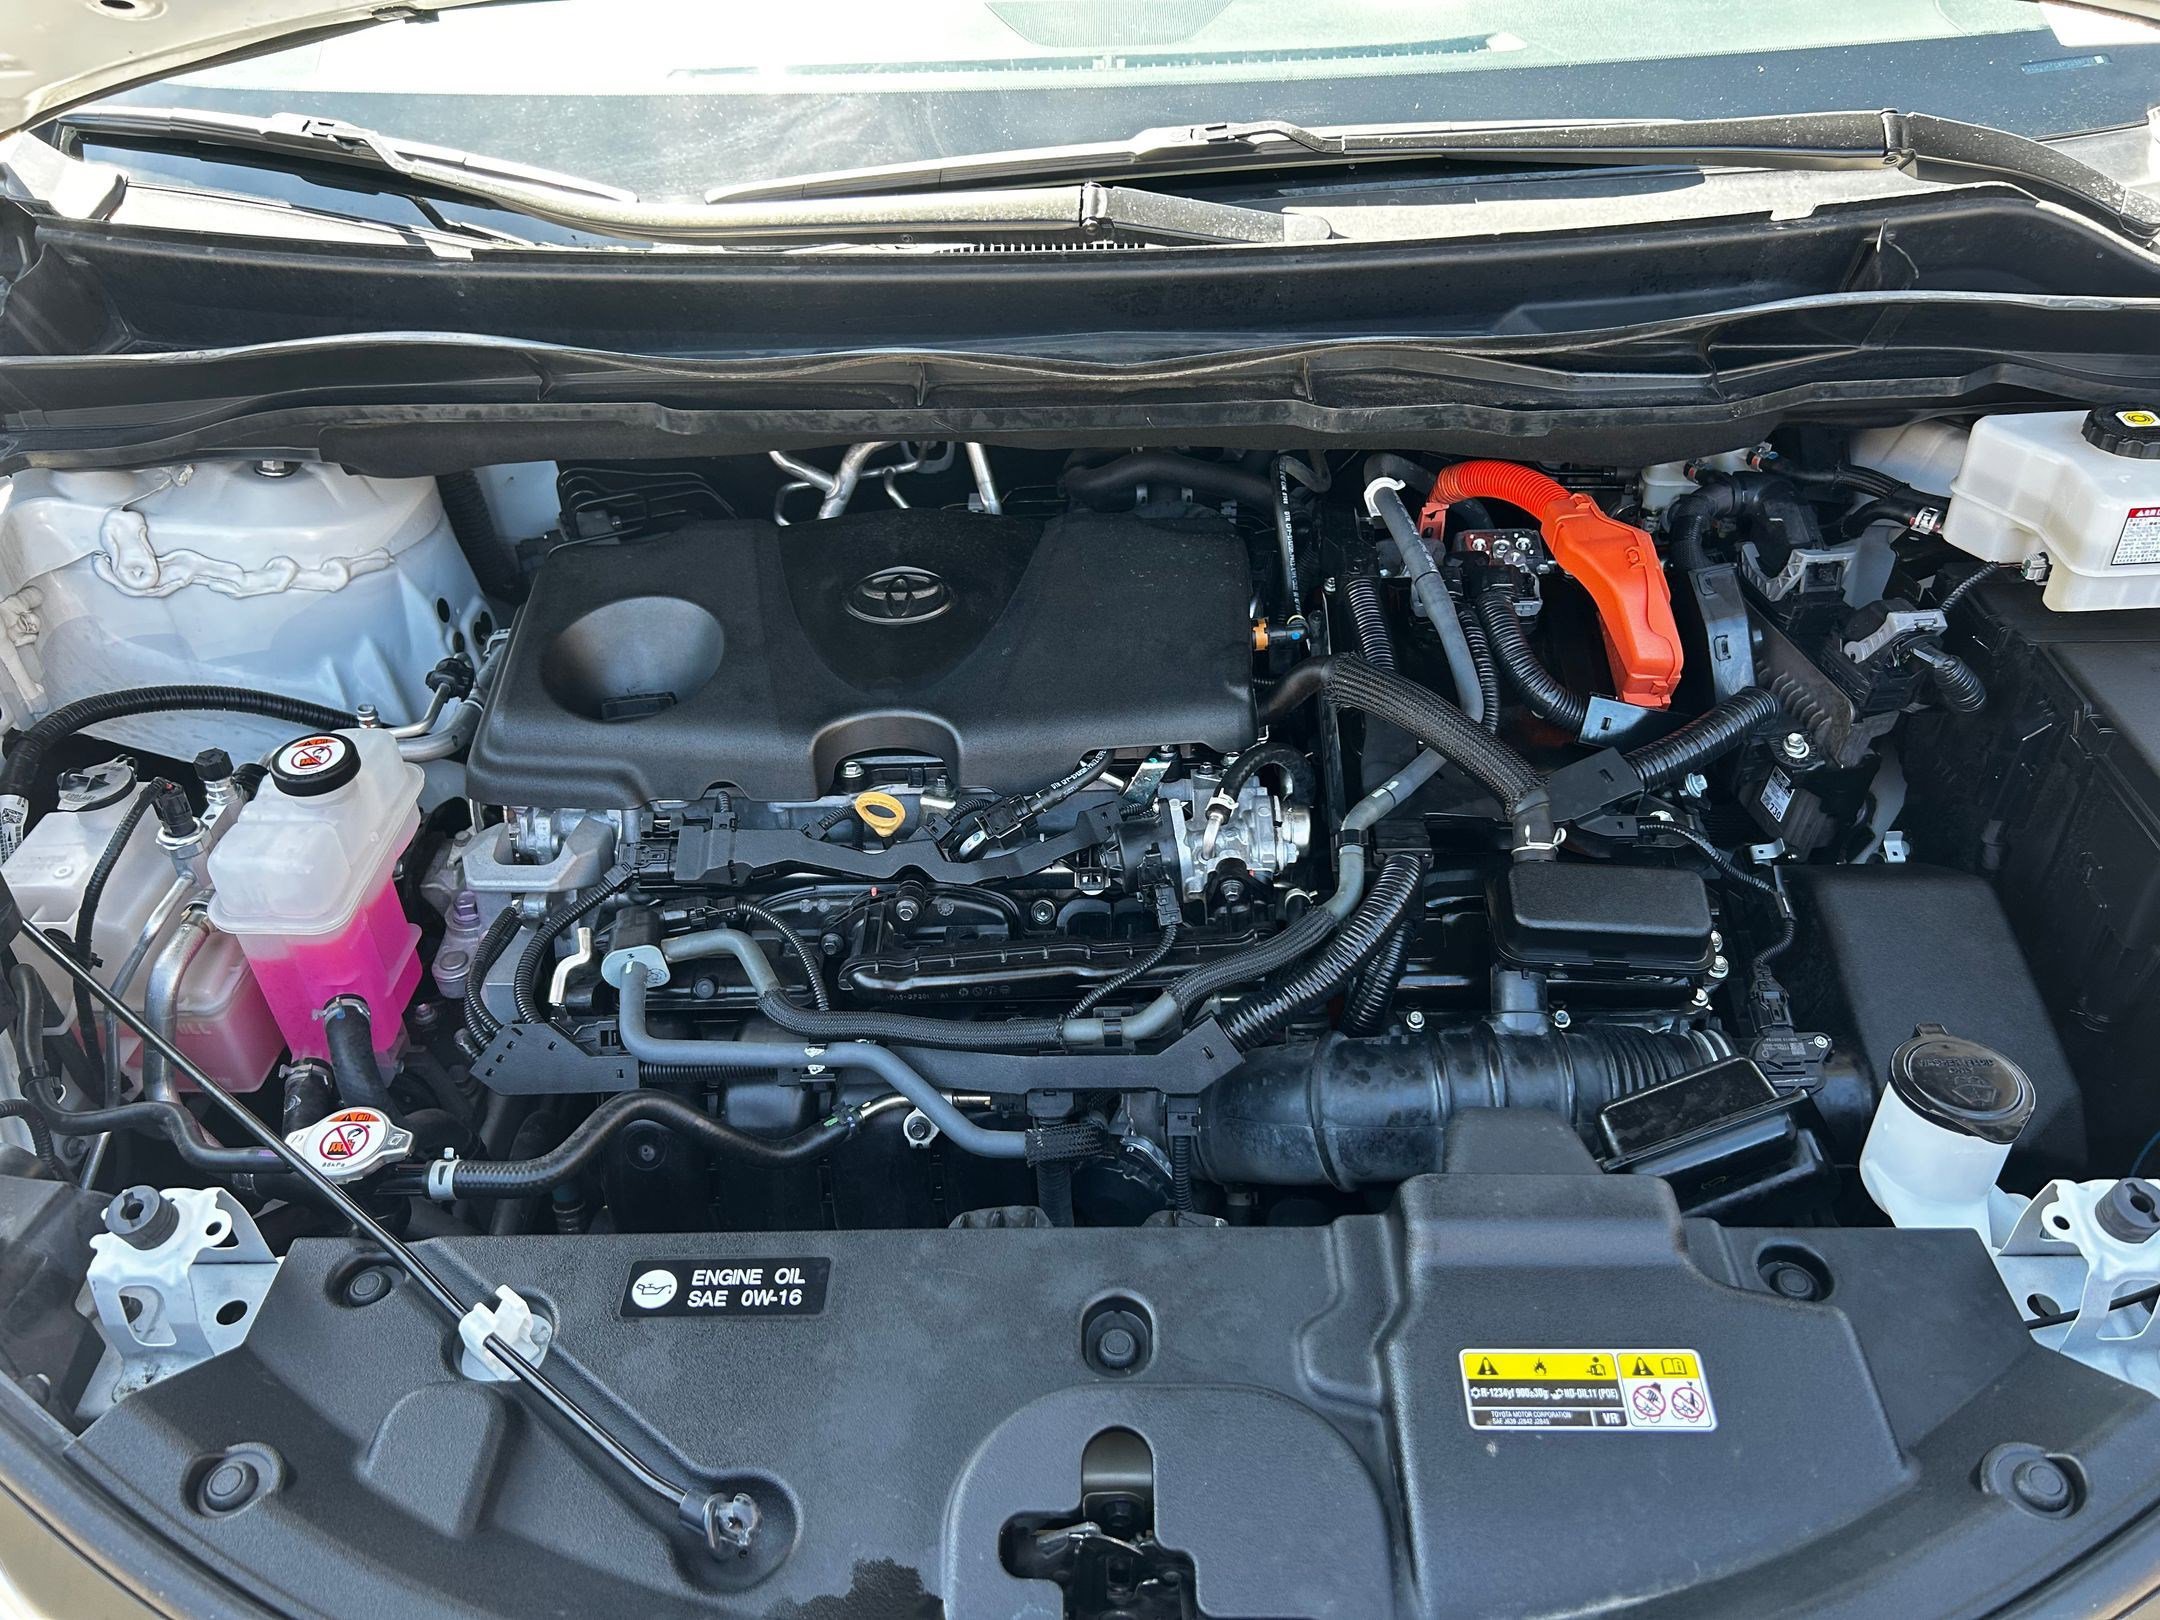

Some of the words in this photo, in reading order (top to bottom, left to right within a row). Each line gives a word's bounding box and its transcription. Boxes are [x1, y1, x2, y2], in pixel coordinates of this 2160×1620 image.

[691, 1268, 763, 1286] ENGINE
[774, 1267, 806, 1285] OIL
[687, 1290, 728, 1308] SAE
[740, 1289, 803, 1307] 0W-16
[1598, 1388, 1619, 1400] (POE)
[1490, 1410, 1512, 1418] TOYOTA
[1512, 1410, 1533, 1418] MOTOR
[1533, 1410, 1572, 1419] CORPORATION
[1602, 1412, 1621, 1425] VR
